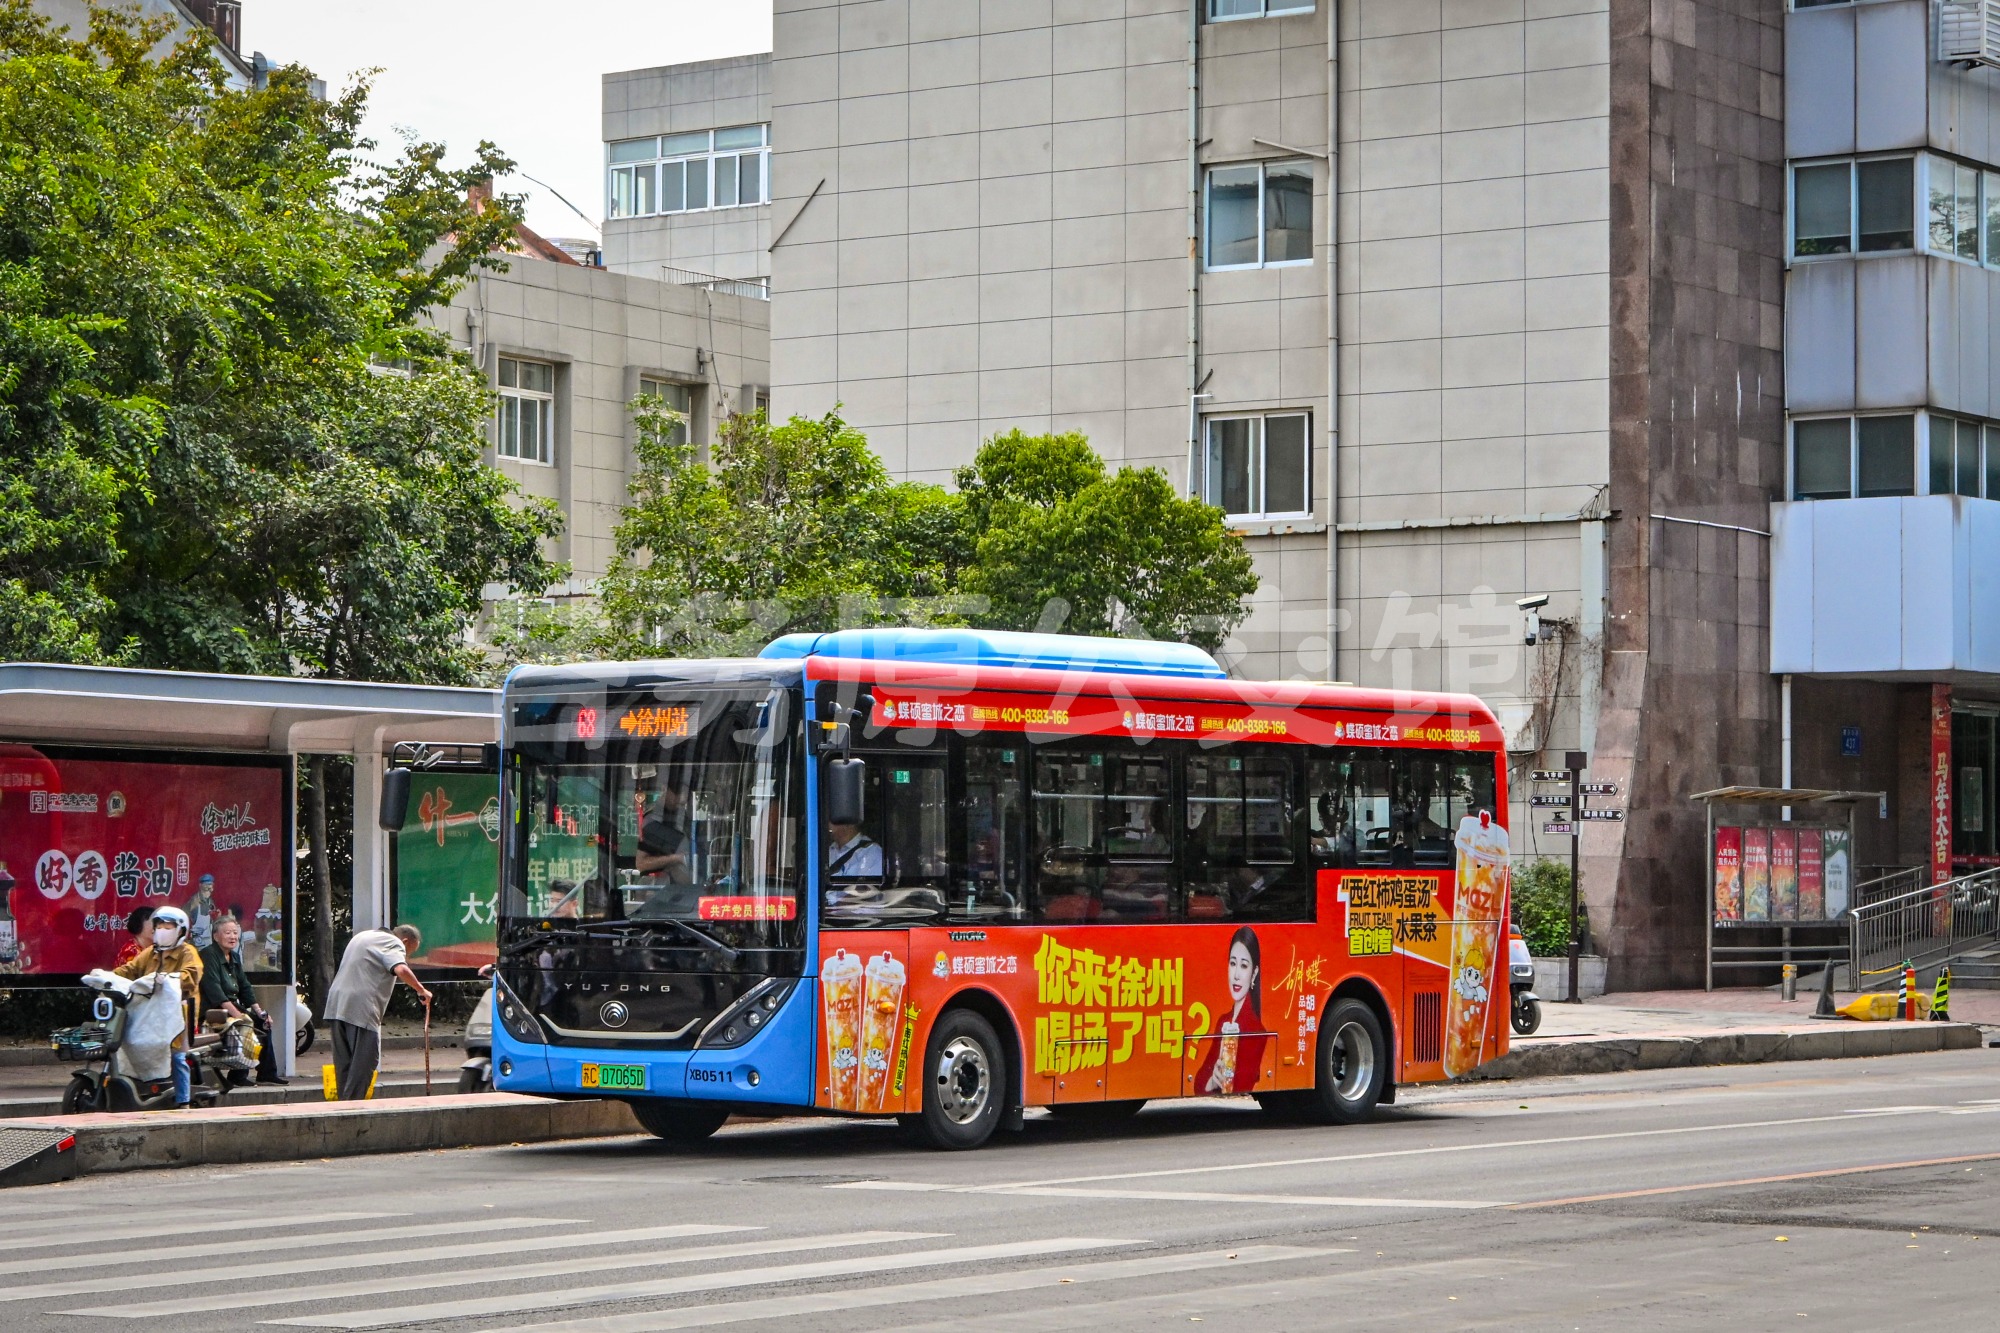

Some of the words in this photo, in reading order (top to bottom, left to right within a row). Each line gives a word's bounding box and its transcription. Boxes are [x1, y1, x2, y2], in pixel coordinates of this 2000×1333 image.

[578, 708, 596, 738] 68
[637, 707, 688, 736] 徐州站
[898, 702, 965, 722] 蝶硕蜜城之恋
[1001, 707, 1069, 725] 400-8383-166
[1135, 713, 1195, 732] 蝶硕蜜城之恋
[1226, 719, 1287, 735] 400-8383-166
[1426, 728, 1481, 743] 400-8383-166
[48, 792, 98, 806] 中华老字号
[200, 802, 255, 835] 徐州人
[213, 828, 270, 851] 记忆中的味道
[38, 851, 174, 898] 好香酱油
[177, 855, 189, 883] 生抽
[710, 904, 787, 918] 共产党员先锋岗
[1349, 912, 1371, 926] FRUIT
[1372, 912, 1393, 926] TEA!!!
[948, 931, 987, 942] YUTONG
[1395, 912, 1437, 942] 水果茶
[1348, 926, 1393, 956] 首创者
[952, 955, 1017, 975] 蝶硕蜜城之恋
[1033, 933, 1184, 1007] 你来徐州
[564, 983, 671, 993] YUTONG
[1034, 1001, 1211, 1075] 喝汤了吗?
[1297, 995, 1307, 1067] 品牌创始人
[689, 1068, 733, 1083] XB0511
